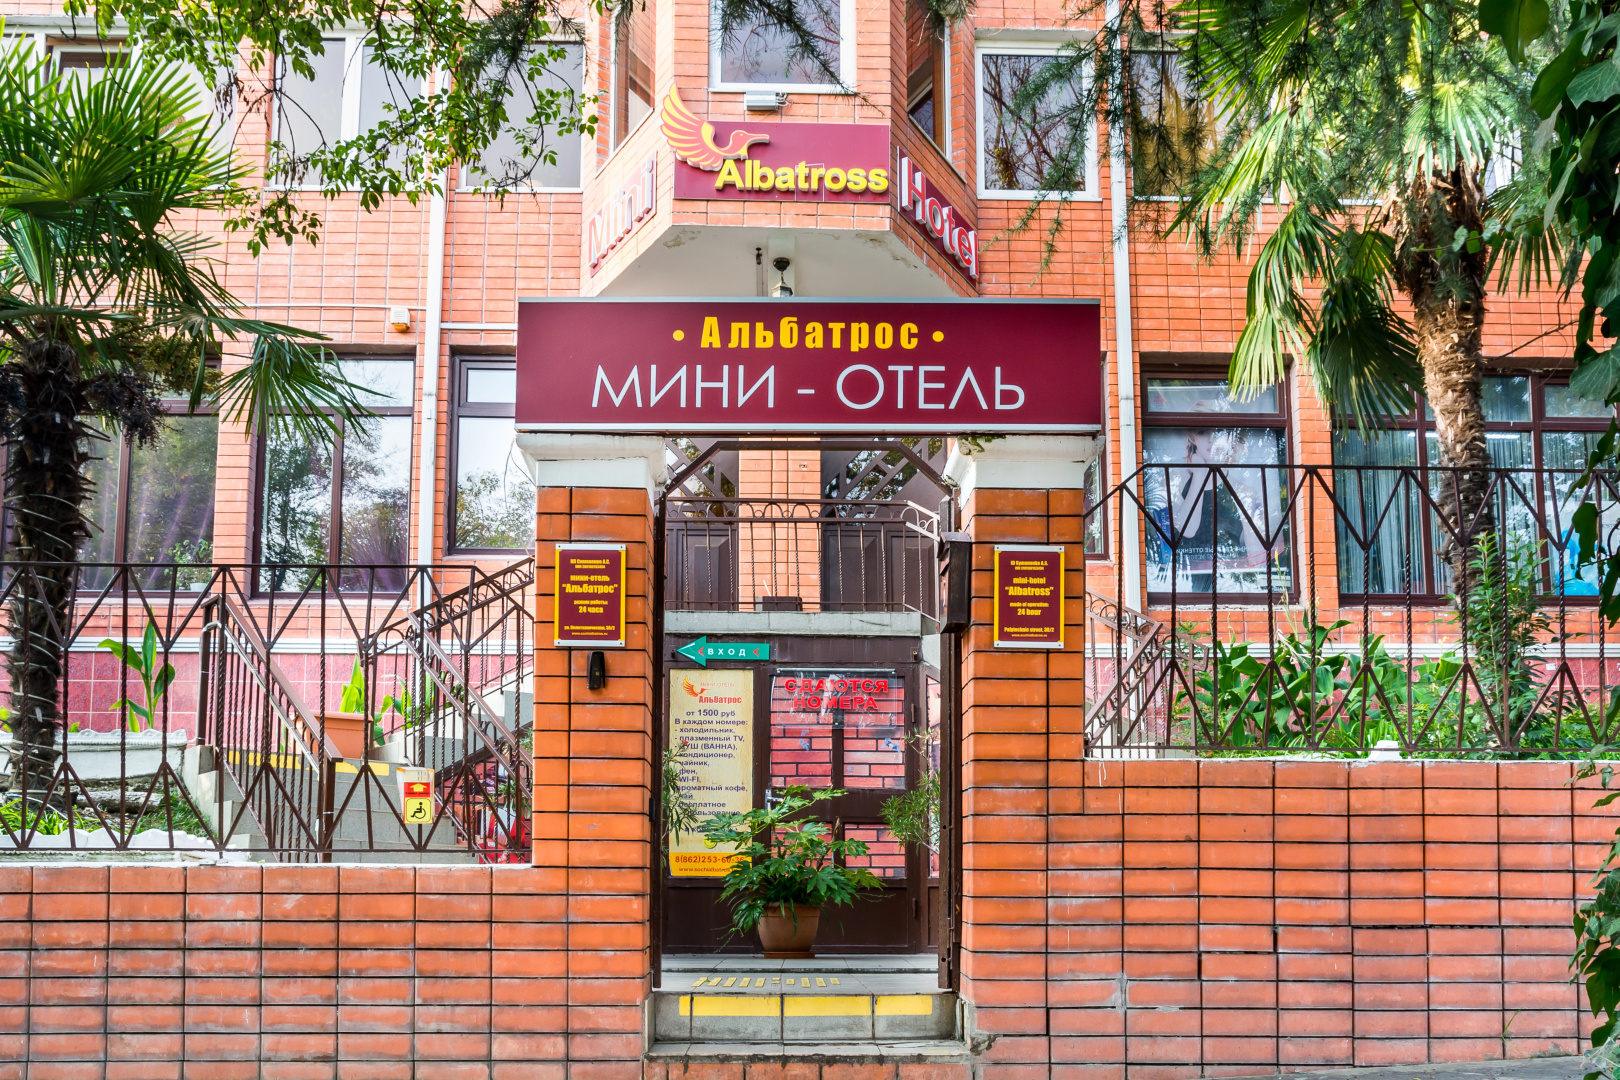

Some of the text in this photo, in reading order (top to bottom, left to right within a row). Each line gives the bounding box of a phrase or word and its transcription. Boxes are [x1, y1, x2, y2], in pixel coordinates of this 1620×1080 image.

[715, 159, 888, 193] Albatross
[588, 158, 653, 268] Mini
[902, 157, 979, 279] Hotel
[700, 316, 918, 352] Альбатрос
[592, 364, 774, 408] МИНИ
[836, 364, 1025, 410] ОТЕЛЬ
[707, 648, 746, 656] ВХОД
[699, 696, 742, 704] Альбатрос
[785, 679, 888, 694] СДАЮТСЯ
[793, 696, 878, 709] НОМЕРА
